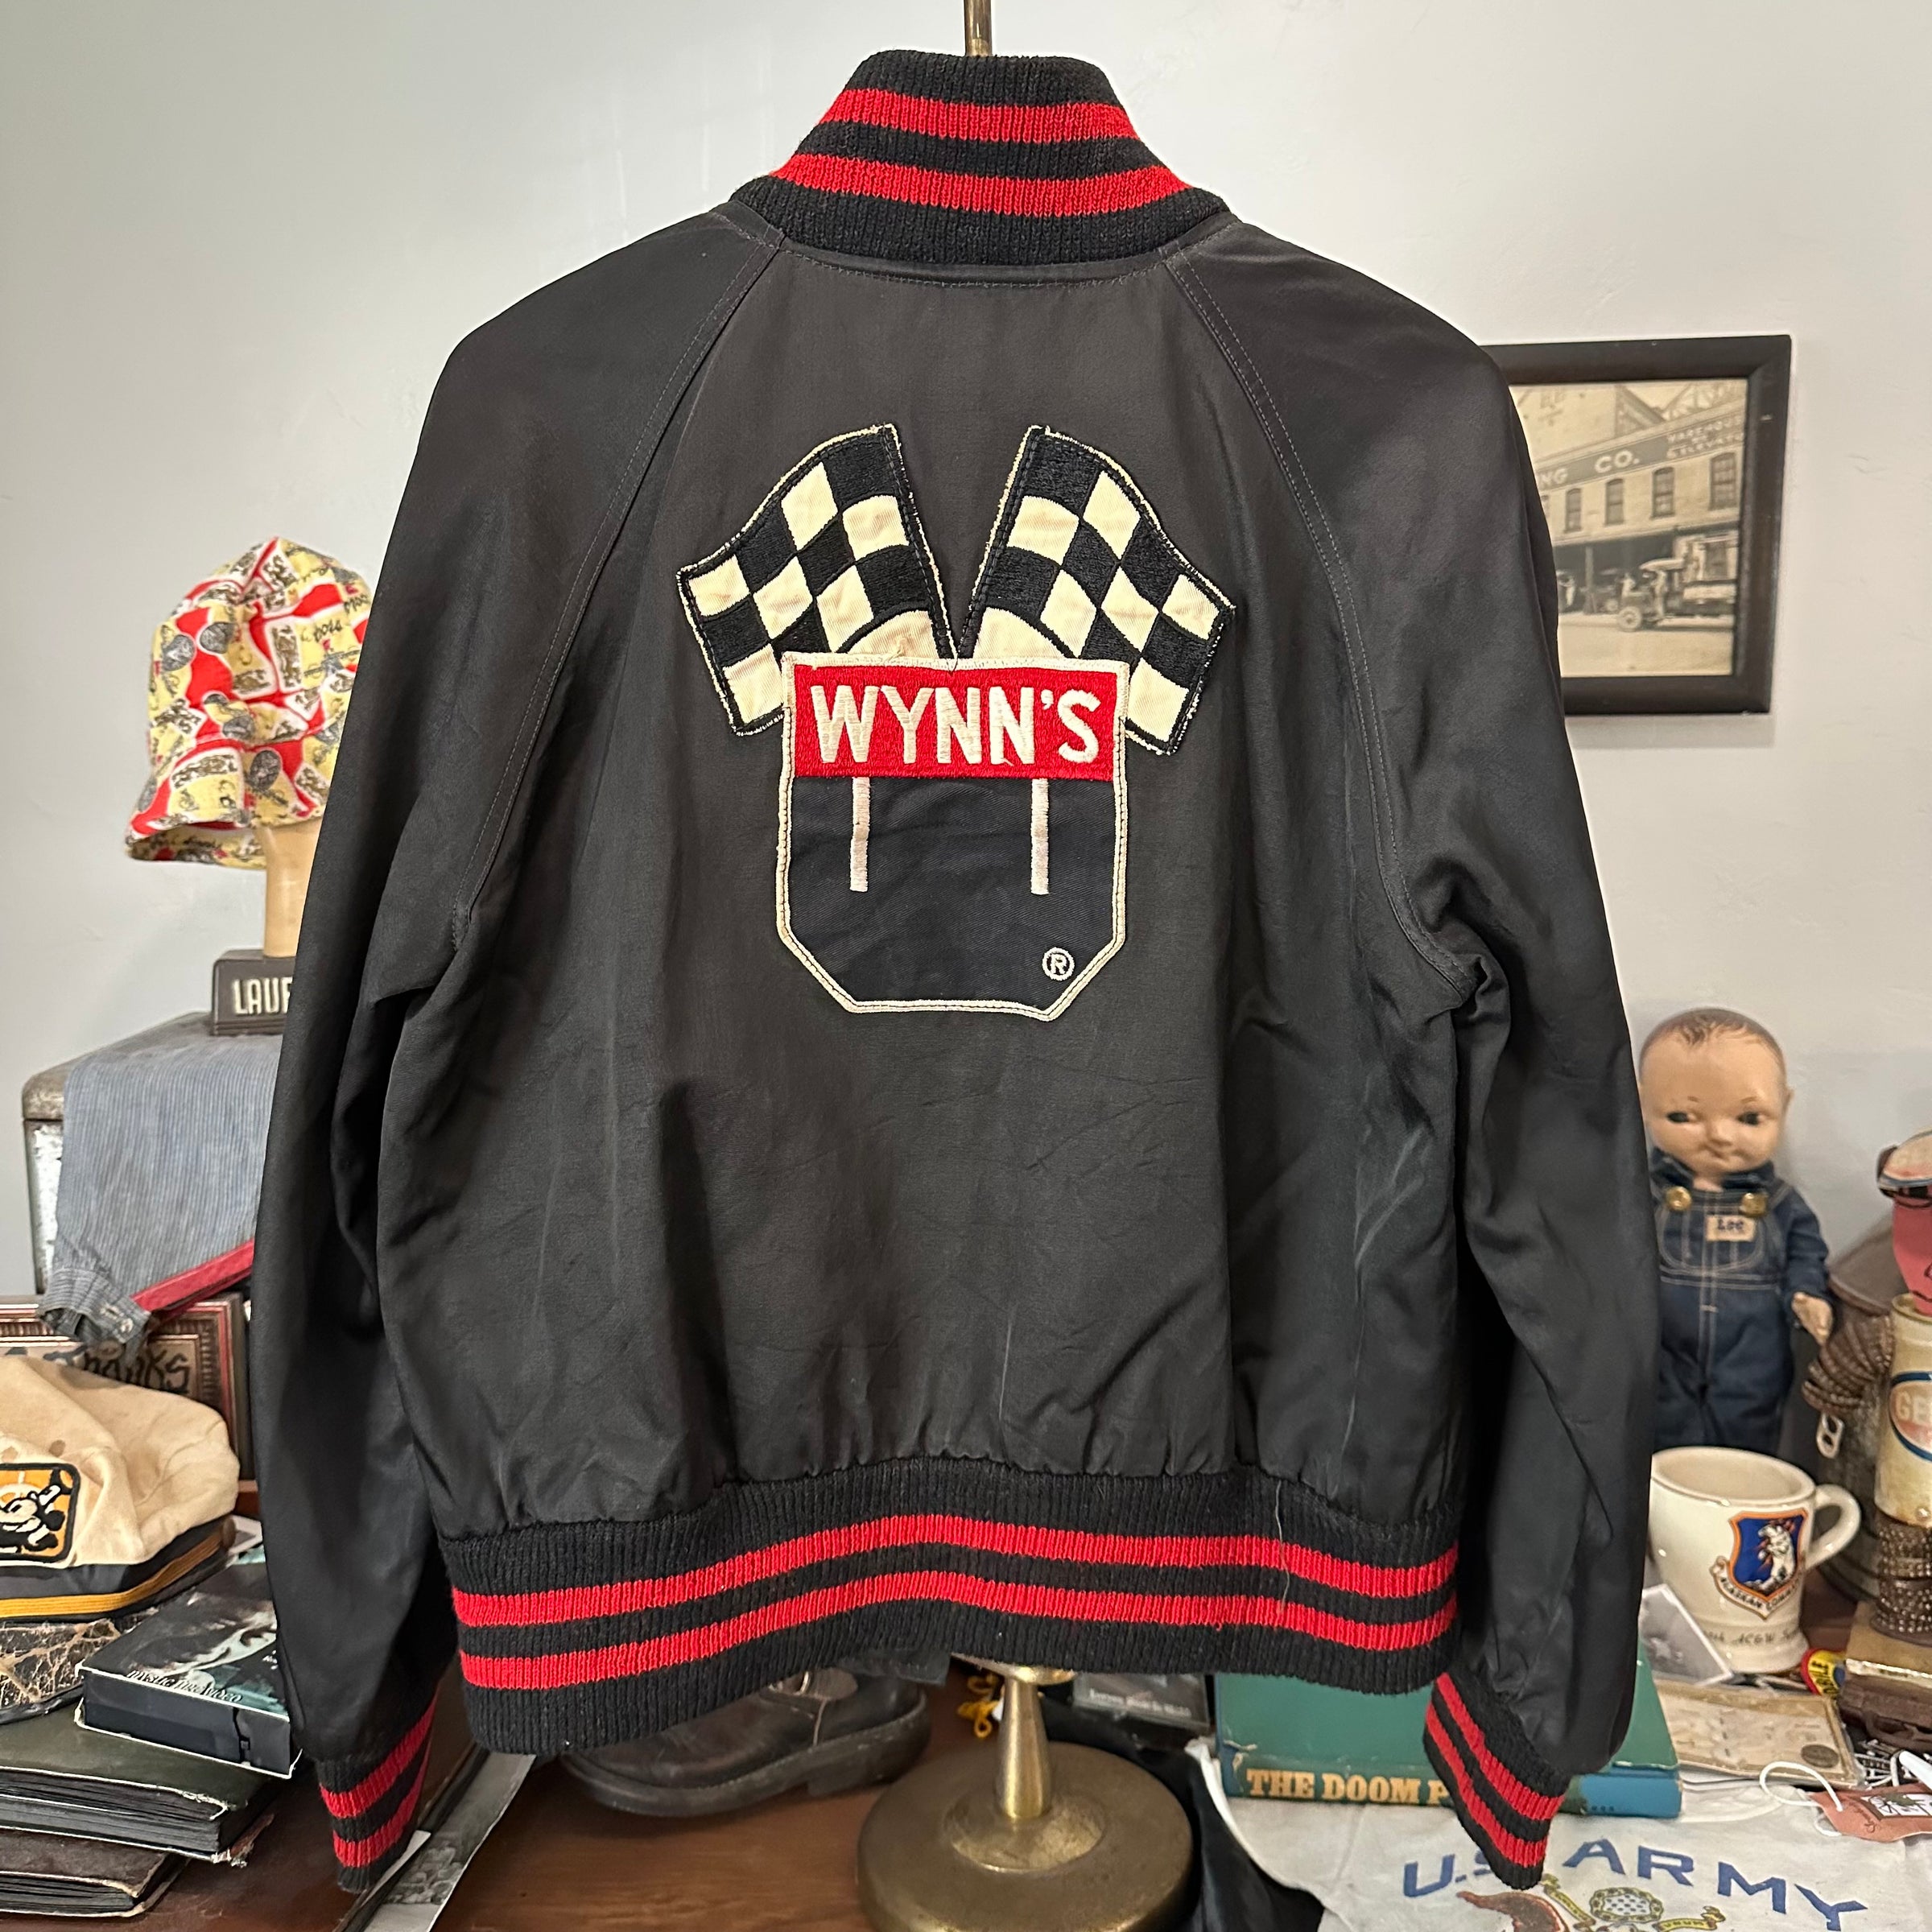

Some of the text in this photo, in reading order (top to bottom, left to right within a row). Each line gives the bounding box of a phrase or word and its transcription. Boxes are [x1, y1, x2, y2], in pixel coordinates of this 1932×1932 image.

[1595, 450, 1640, 473] CO.
[810, 684, 1101, 766] WYNN'S
[1247, 1769, 1315, 1798] THE
[1322, 1773, 1421, 1805] DOOM
[1563, 1839, 1868, 1931] ARMY
